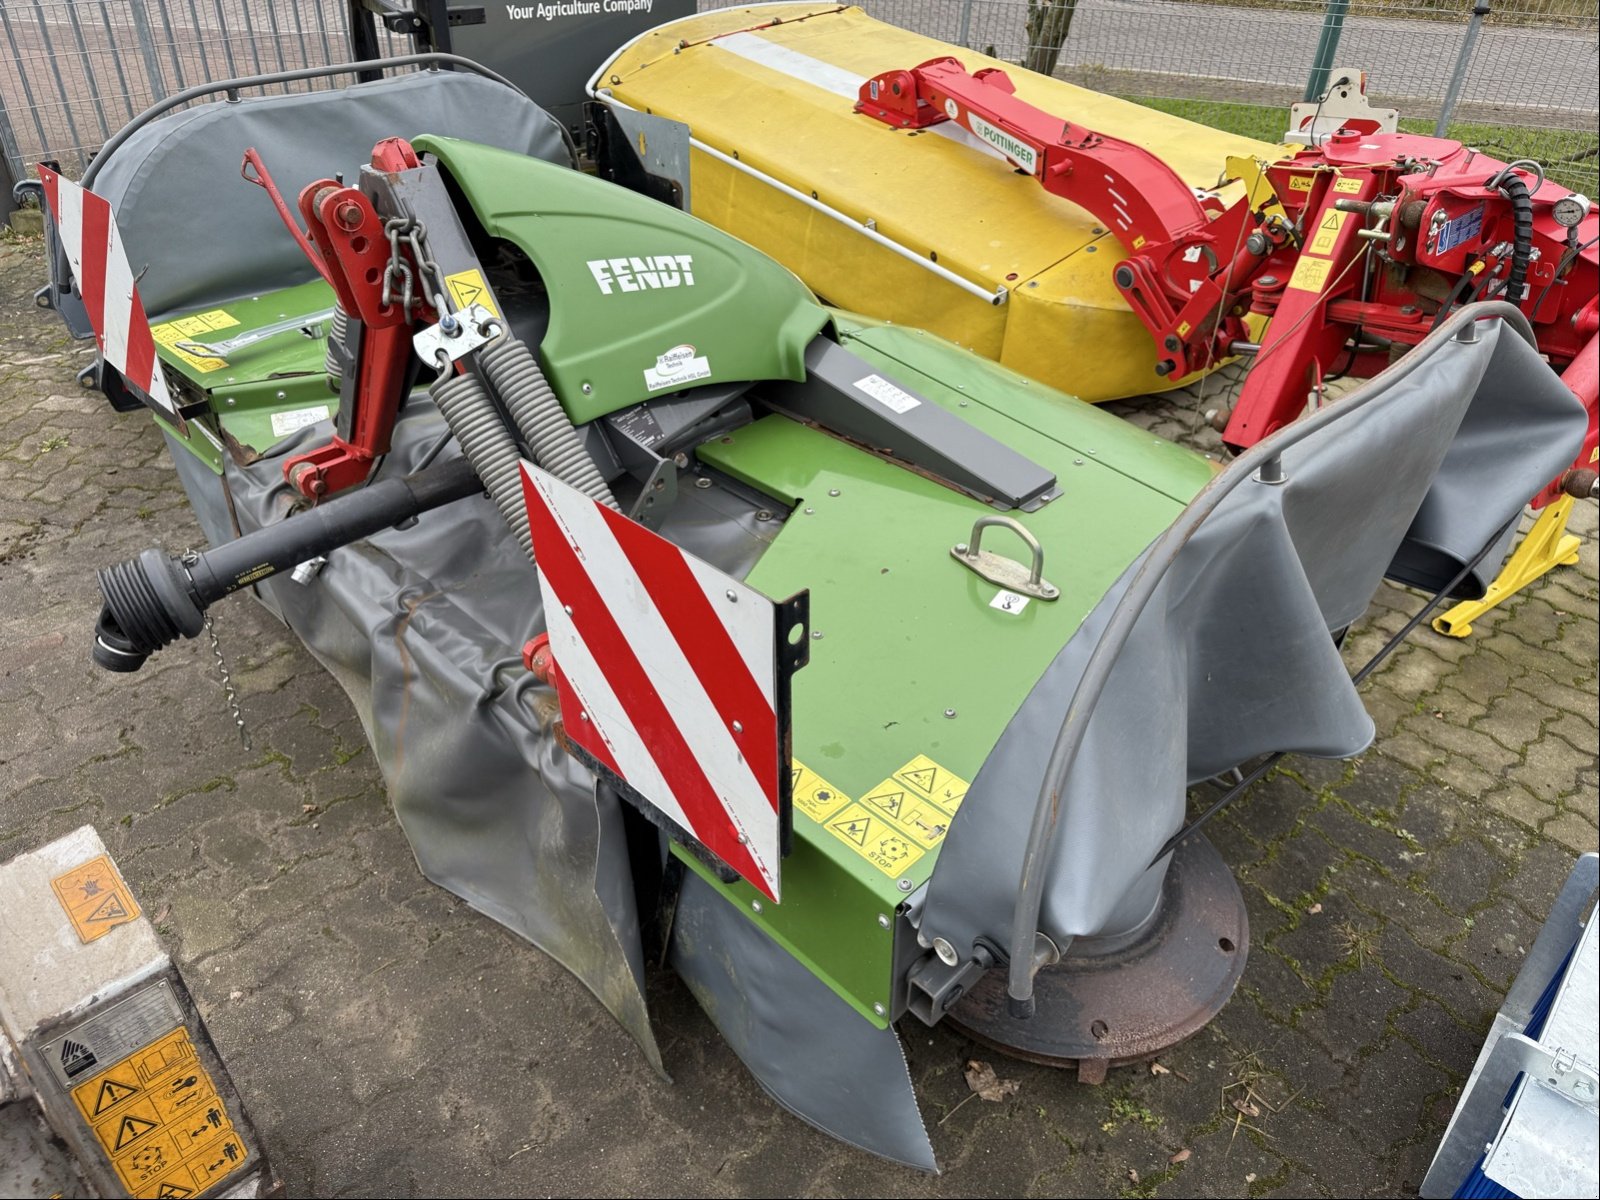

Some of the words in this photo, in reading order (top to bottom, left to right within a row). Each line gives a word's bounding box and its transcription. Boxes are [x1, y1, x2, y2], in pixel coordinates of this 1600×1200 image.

[506, 4, 534, 20] Your
[536, 0, 600, 21] Agriculture
[603, 0, 653, 14] Company
[586, 255, 695, 294] FENDT
[868, 851, 893, 869] STOP
[140, 1160, 168, 1181] STOP
